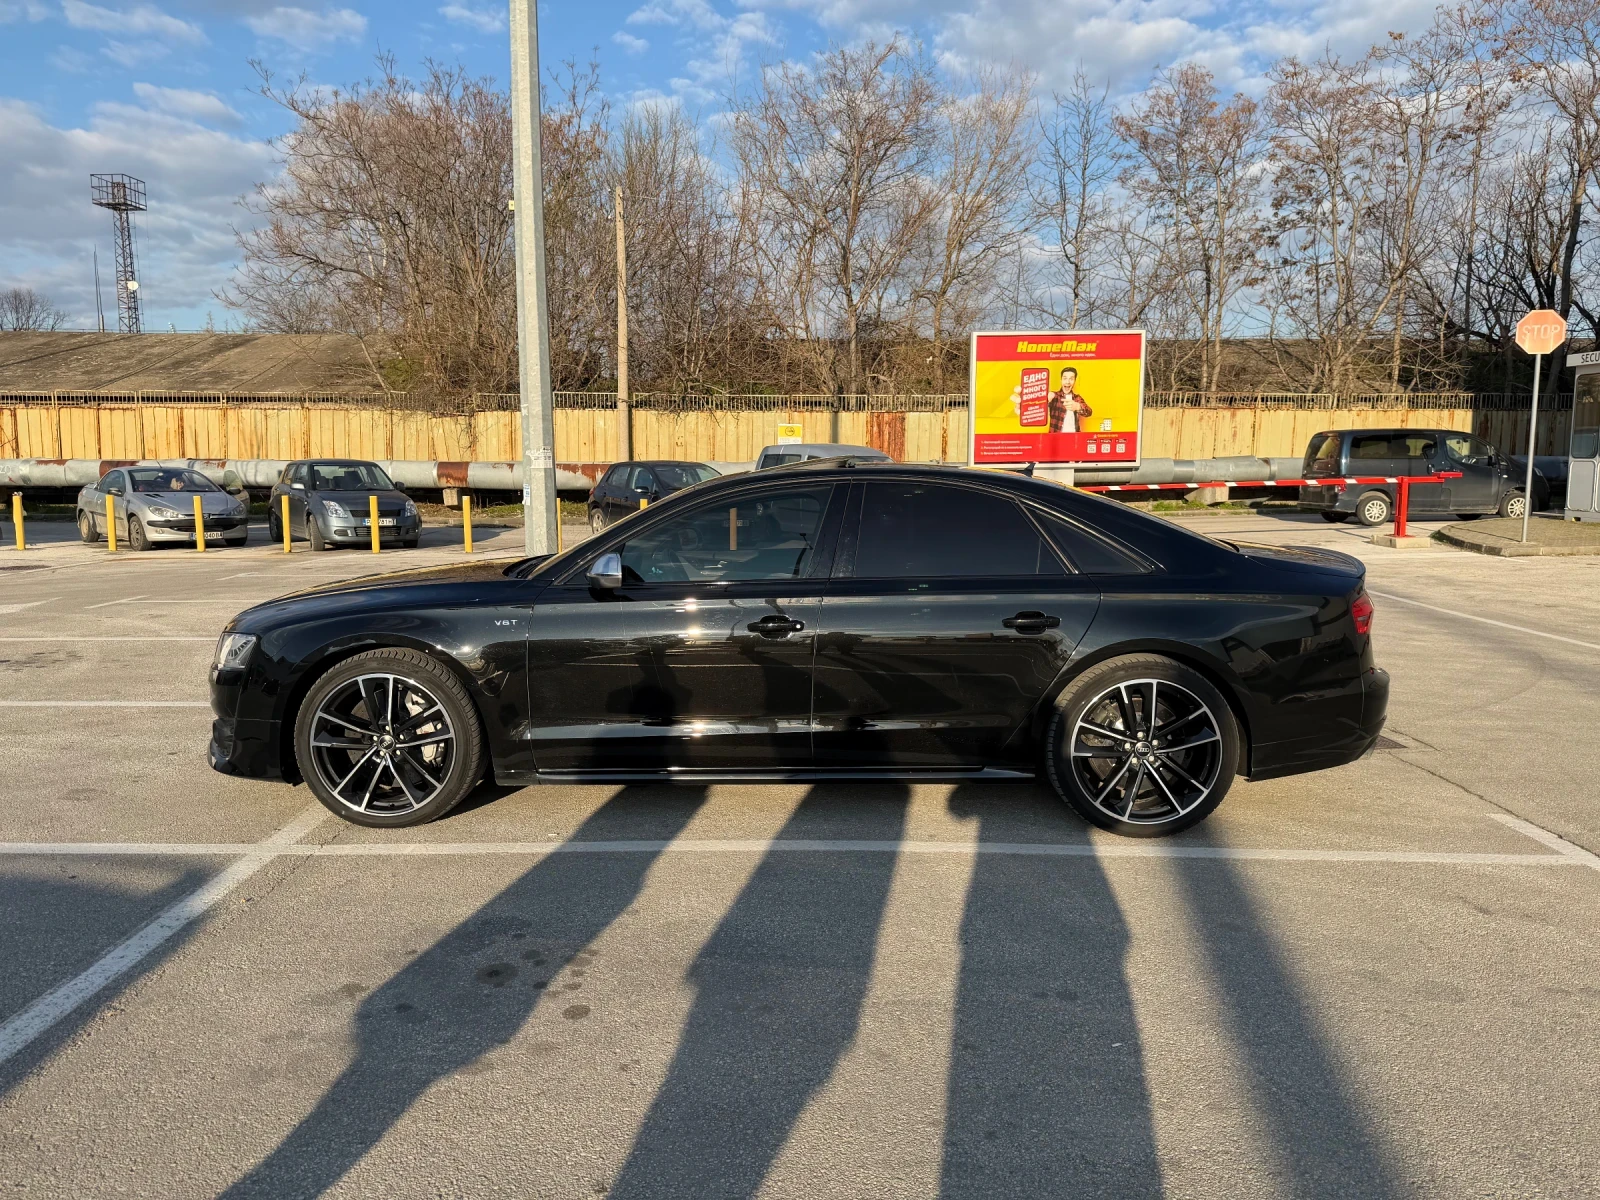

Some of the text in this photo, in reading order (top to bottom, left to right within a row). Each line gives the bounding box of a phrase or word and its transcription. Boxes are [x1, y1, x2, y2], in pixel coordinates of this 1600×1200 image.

[1522, 324, 1560, 340] STOP
[1017, 340, 1097, 353] HomeMax
[1023, 371, 1047, 383] ЕДНО
